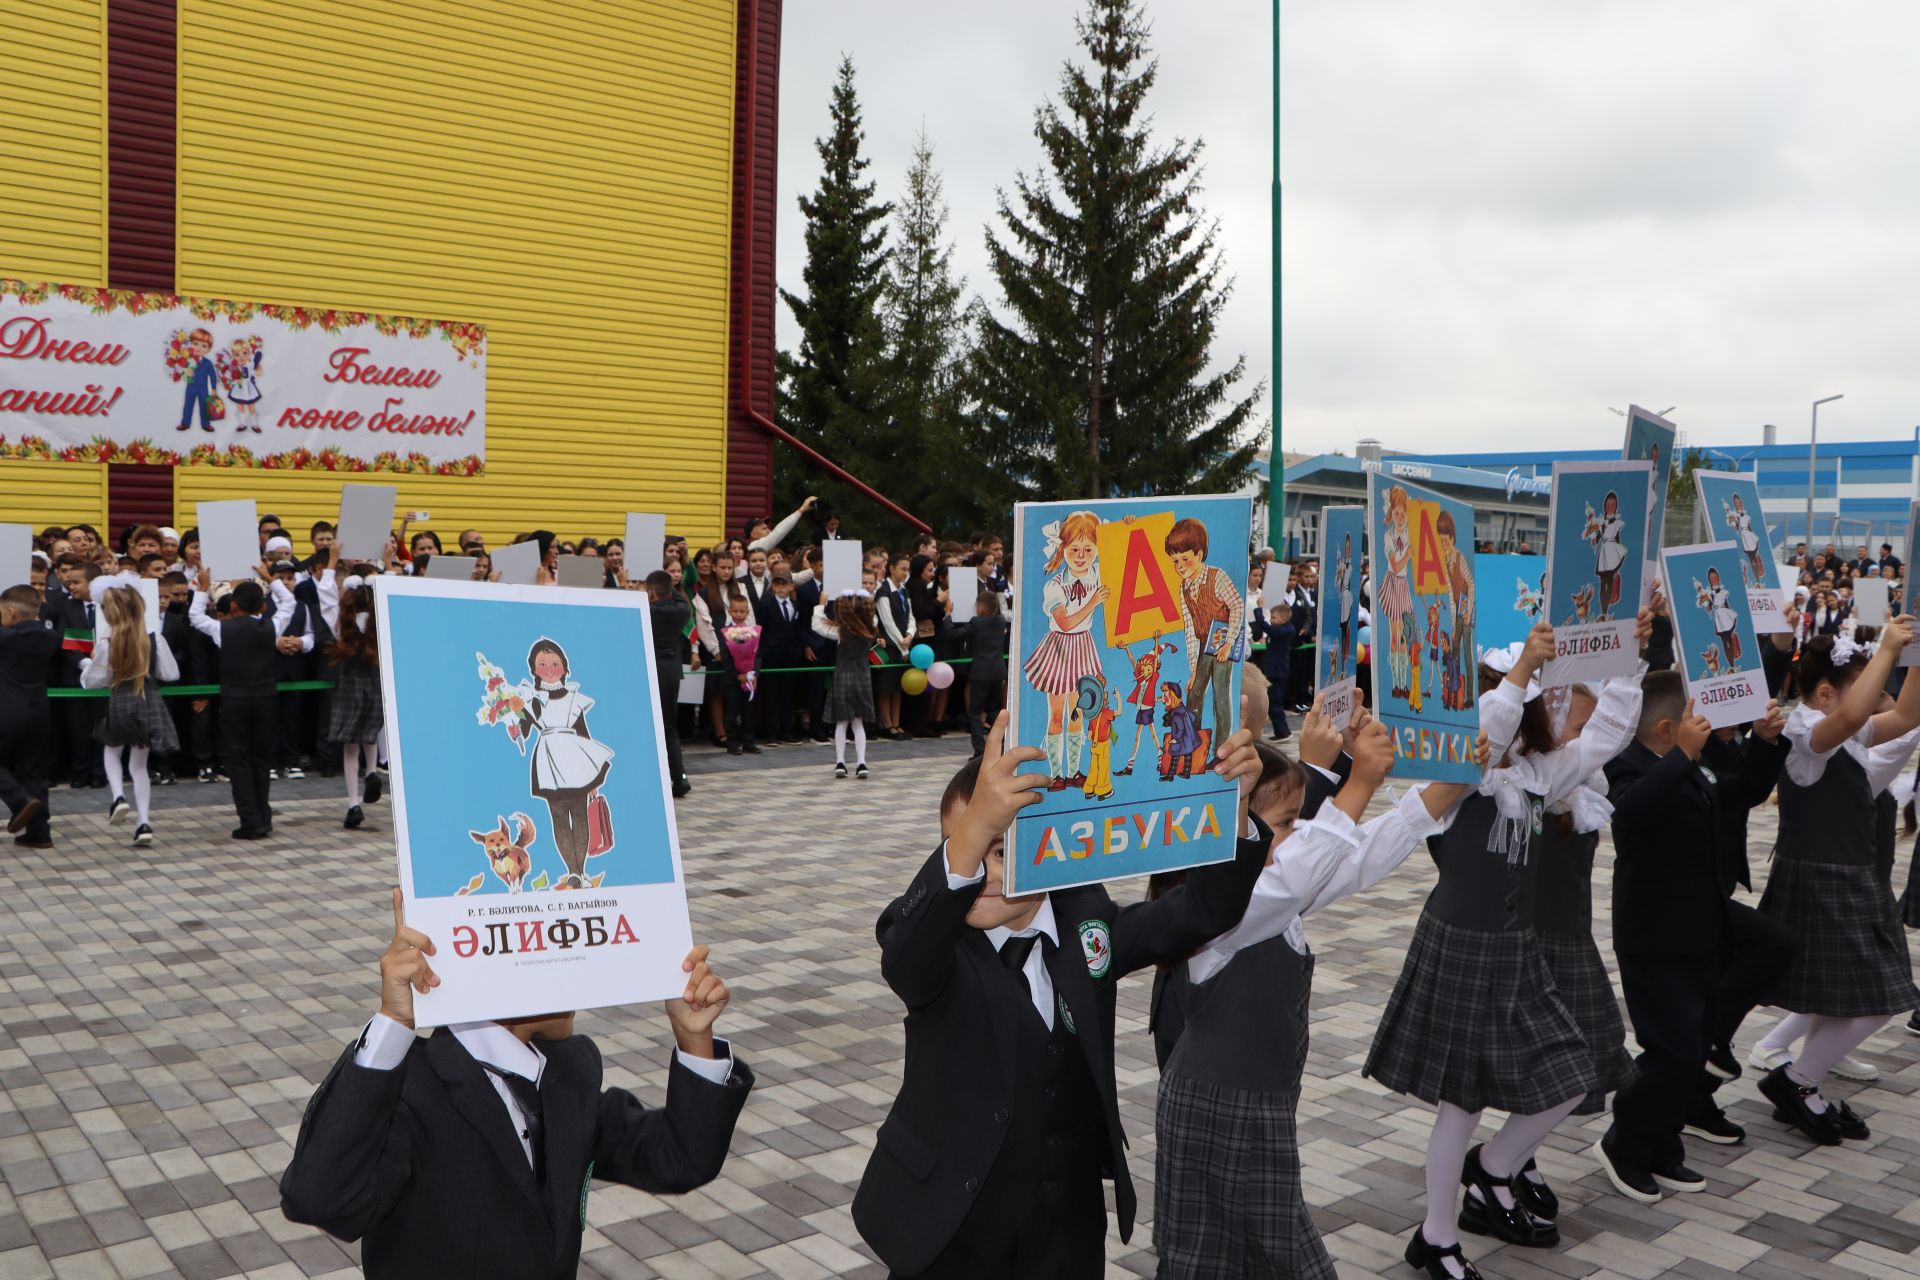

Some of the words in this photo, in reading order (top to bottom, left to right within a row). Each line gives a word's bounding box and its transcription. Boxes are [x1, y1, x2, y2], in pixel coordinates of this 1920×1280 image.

[0, 316, 131, 366] Днем
[323, 347, 441, 389] Белем
[276, 407, 364, 432] көне
[367, 397, 476, 437] белән!
[1417, 509, 1447, 587] А
[1114, 527, 1182, 636] А
[1558, 633, 1621, 657] ӘЛИФБА
[1701, 682, 1754, 705] ӘЛИФБА
[1391, 725, 1476, 765] АЗБУКА
[1033, 803, 1222, 865] АЗБУКА
[468, 908, 476, 917] Р.
[478, 907, 486, 916] Г.
[488, 903, 544, 916] ВӘЛИТОВА,
[547, 903, 557, 912] С.
[558, 902, 566, 911] Г.
[568, 898, 618, 911] ВАГЫЙЗОВ
[452, 913, 640, 958] ӘЛИФБА
